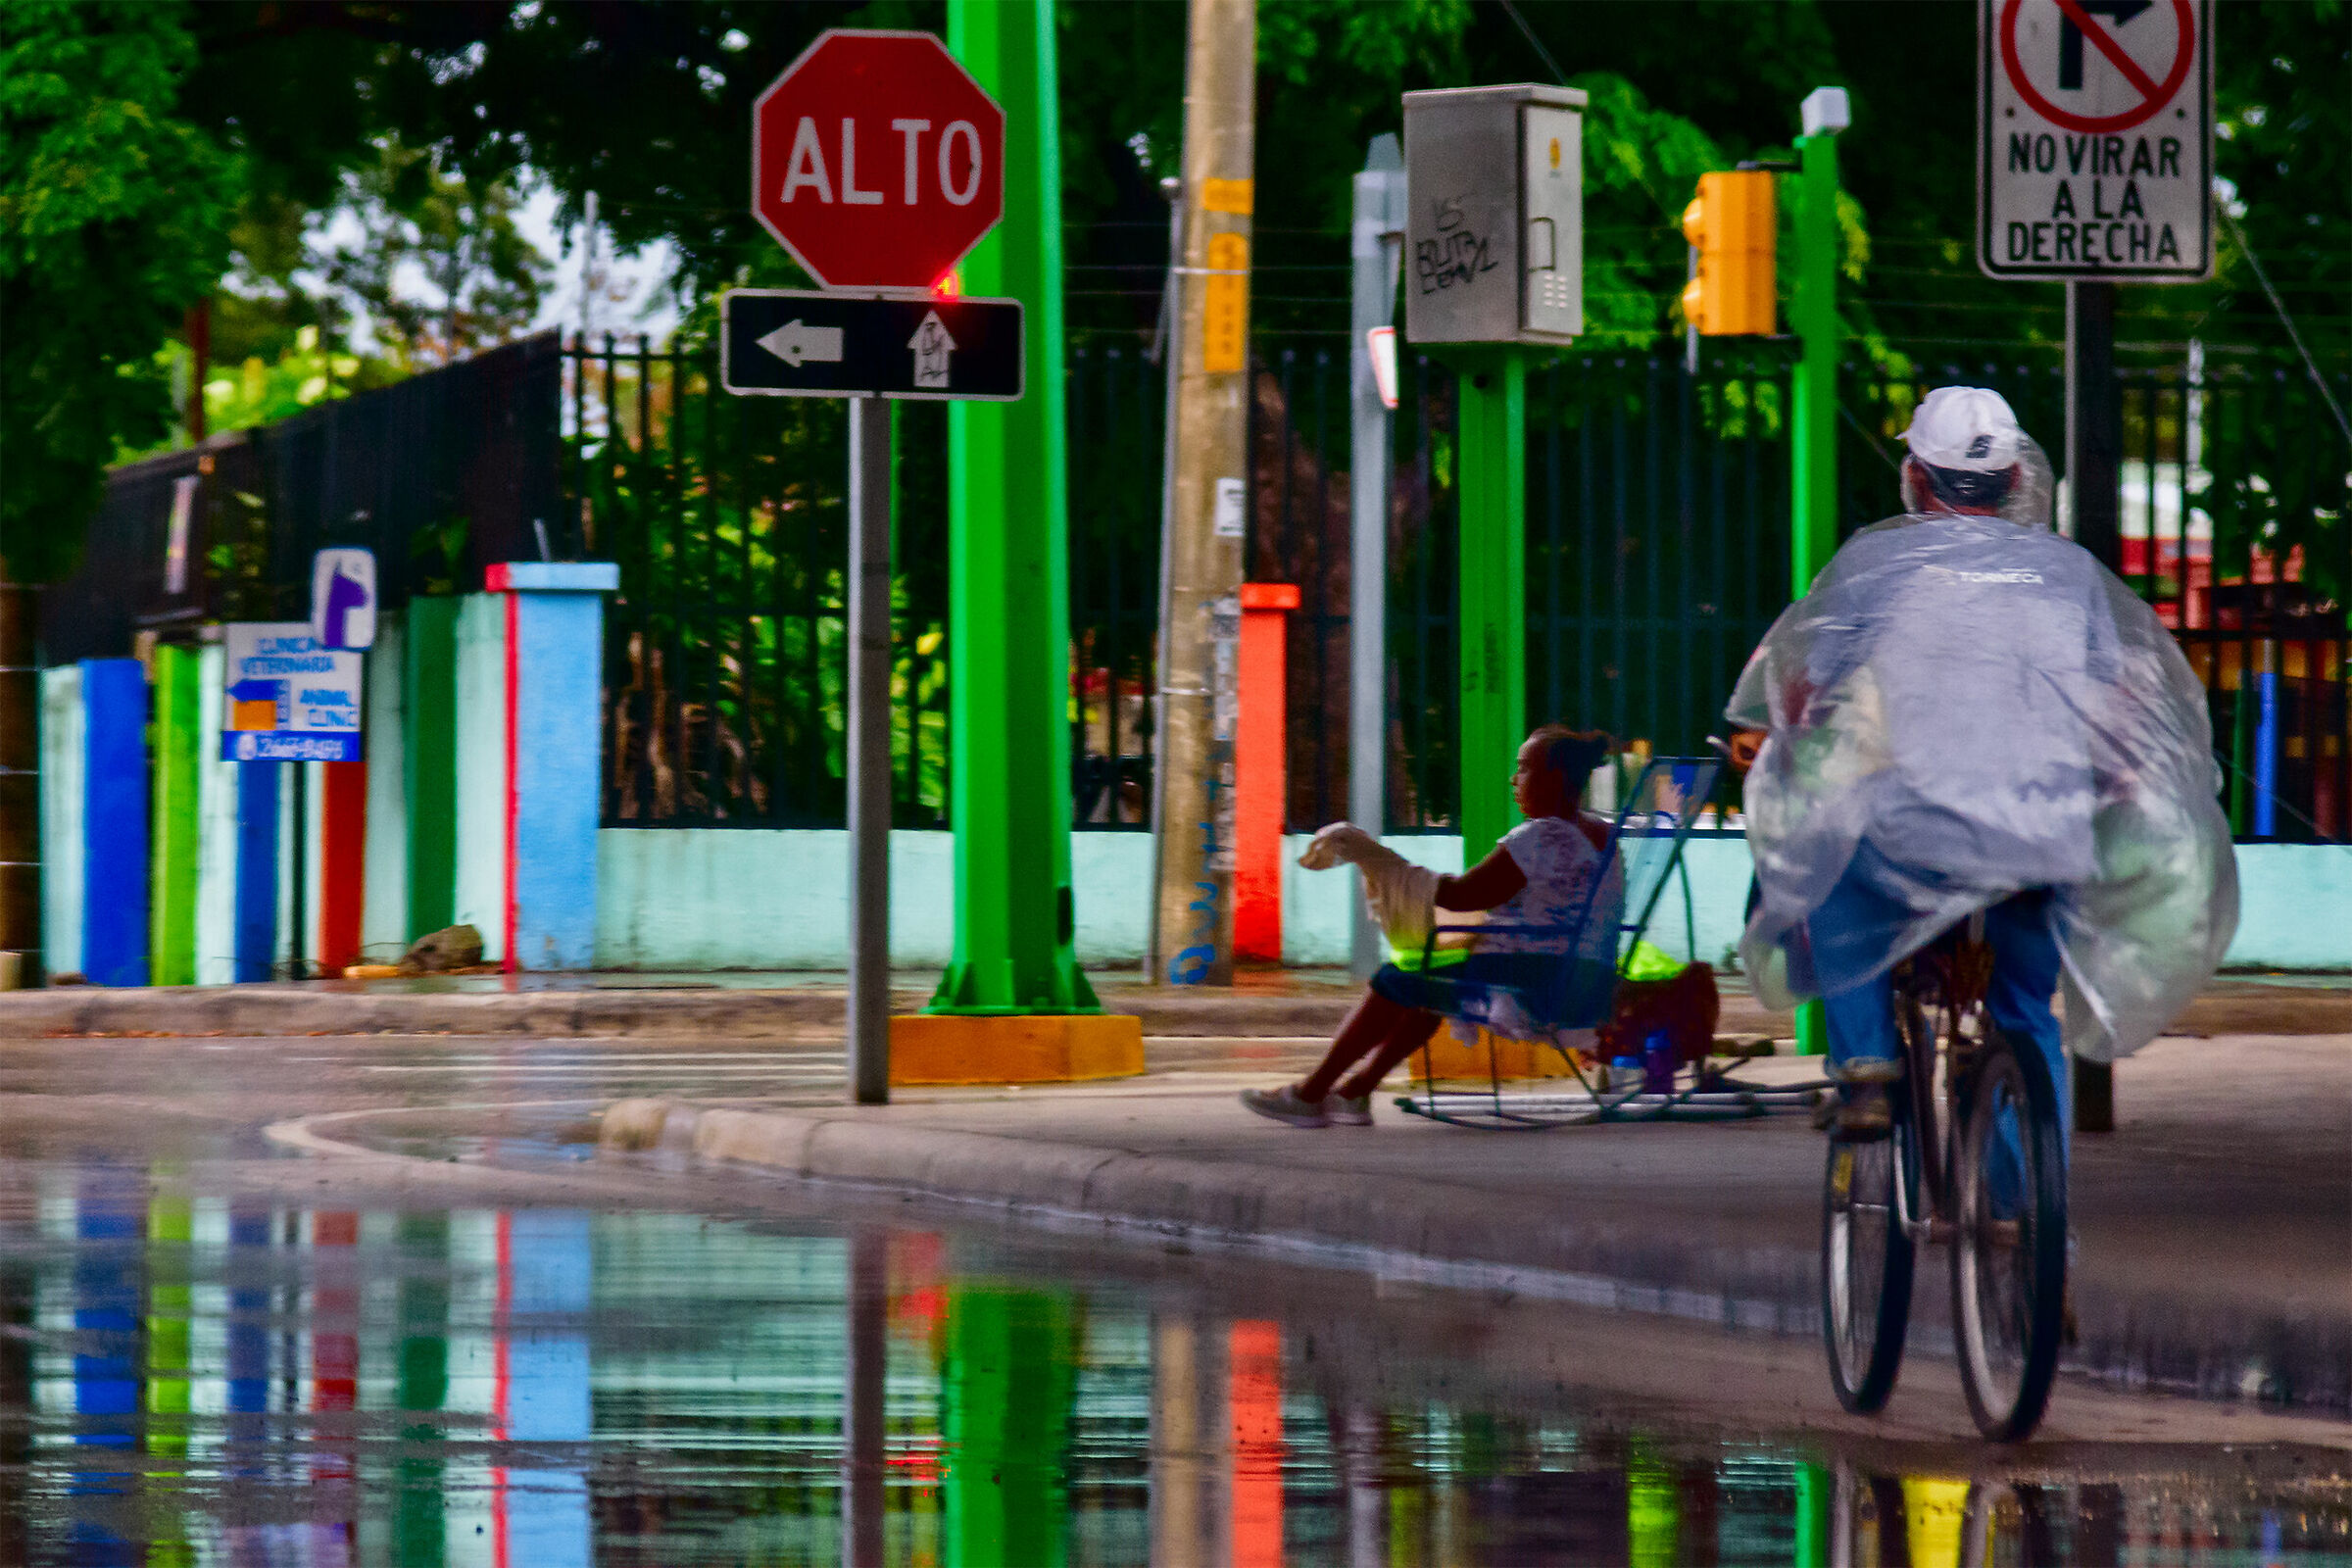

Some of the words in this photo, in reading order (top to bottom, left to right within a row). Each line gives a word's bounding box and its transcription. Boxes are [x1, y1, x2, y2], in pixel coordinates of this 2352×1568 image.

[781, 117, 981, 206] ALTO
[2009, 133, 2056, 173] NO
[2065, 135, 2180, 177] VIRAR
[2052, 179, 2077, 219] A
[2092, 178, 2145, 220] LA
[2007, 221, 2180, 264] DERECHA
